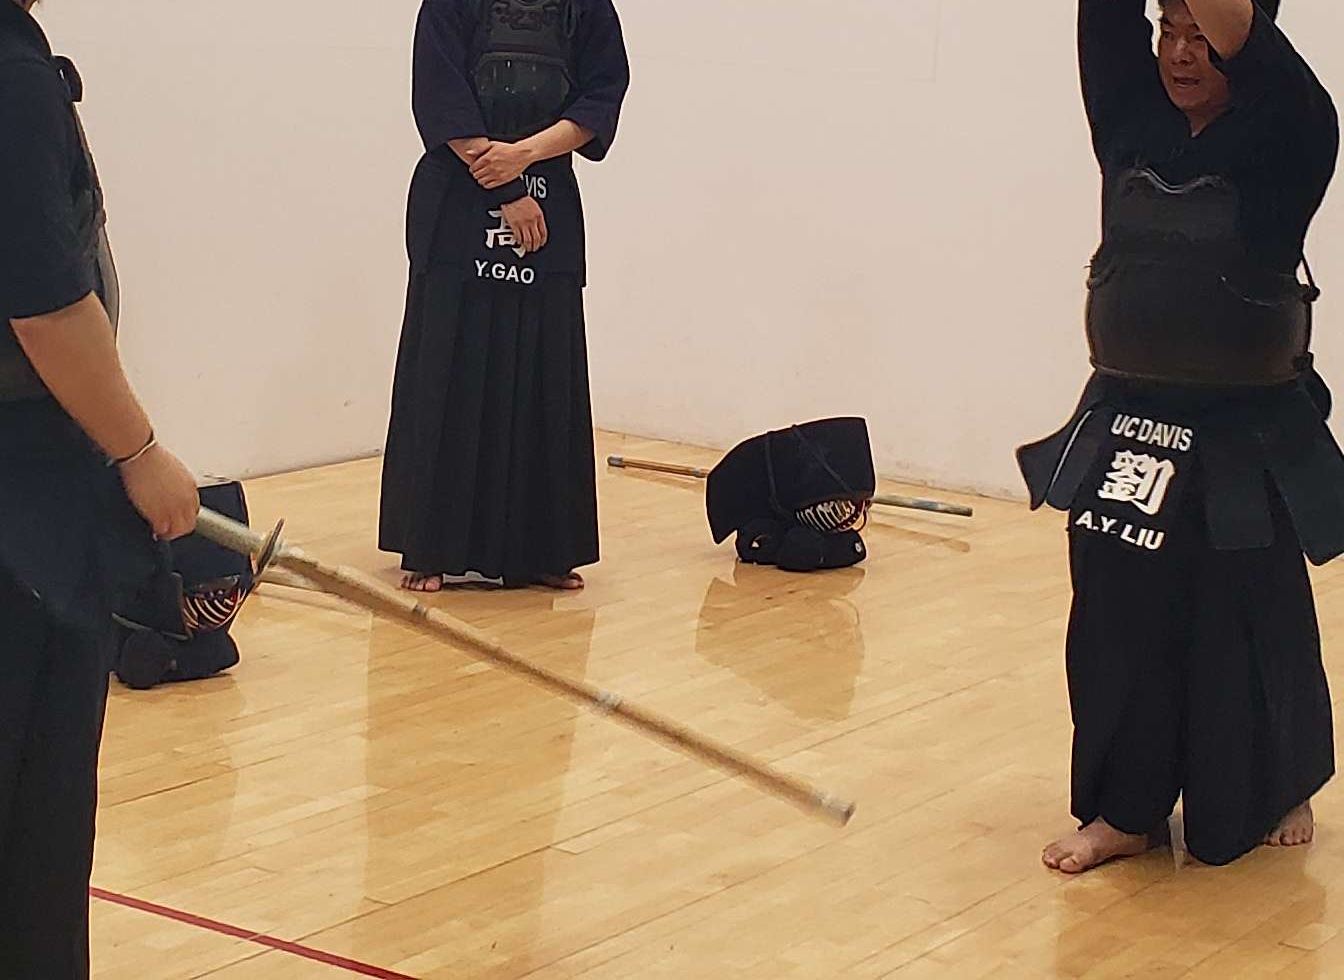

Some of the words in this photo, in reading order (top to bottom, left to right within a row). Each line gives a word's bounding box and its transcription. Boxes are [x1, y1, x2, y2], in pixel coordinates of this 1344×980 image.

[520, 174, 547, 198] VIS
[474, 260, 535, 284] Y.GAO
[1097, 449, 1176, 515] 劉
[1120, 524, 1165, 550] LIU
